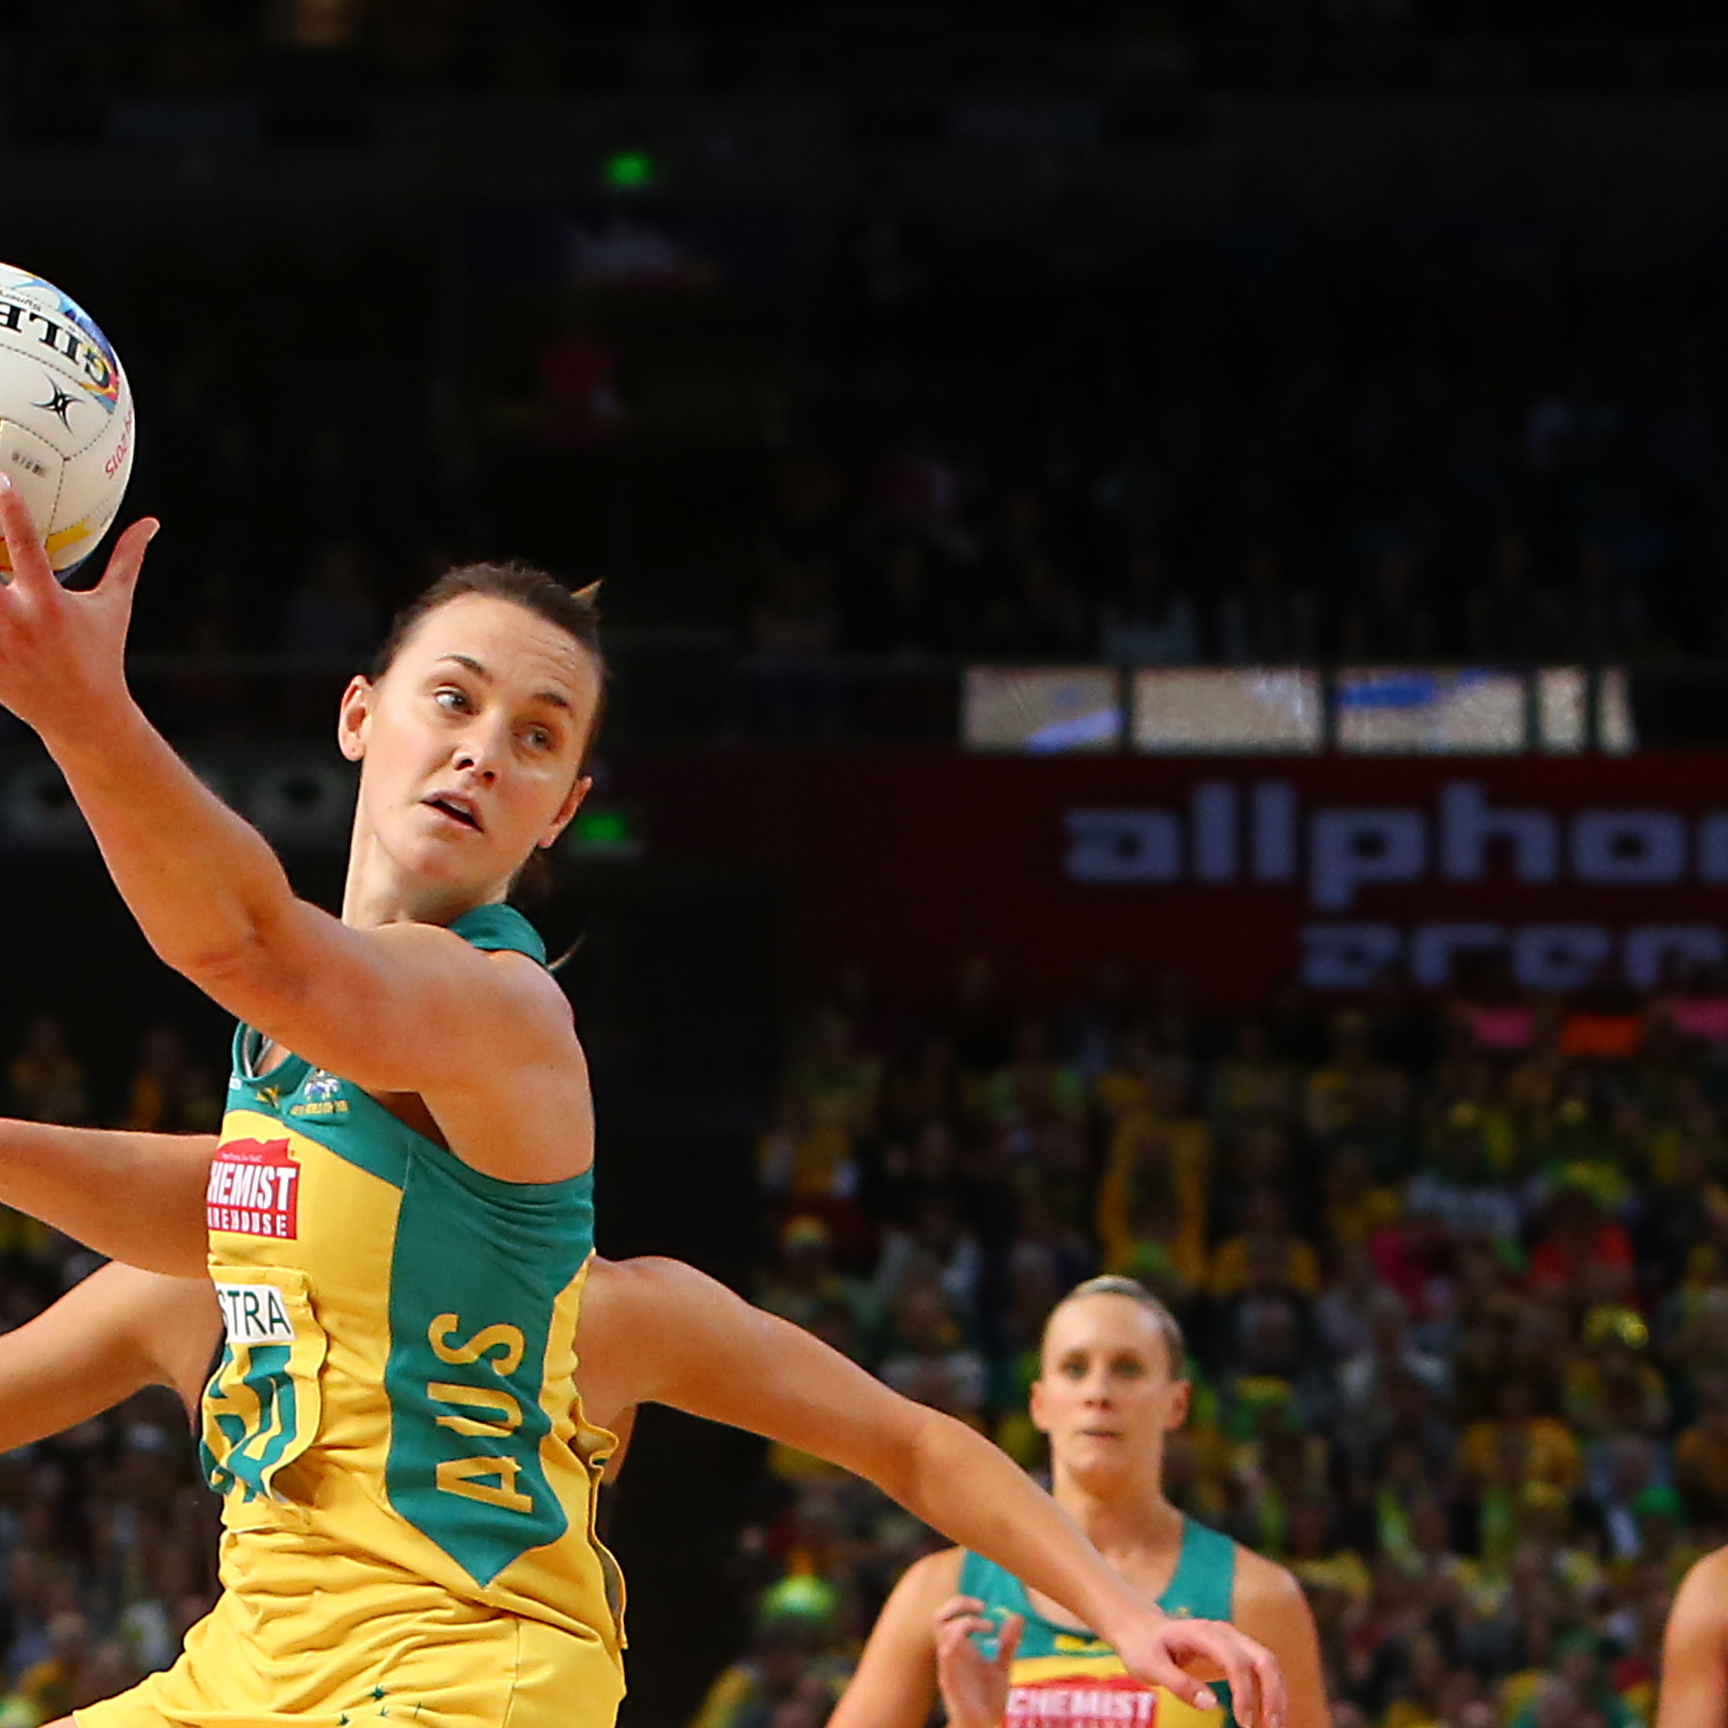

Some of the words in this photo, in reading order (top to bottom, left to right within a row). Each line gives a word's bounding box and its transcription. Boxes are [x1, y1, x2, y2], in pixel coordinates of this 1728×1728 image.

[207, 1161, 297, 1211] HEMIST
[207, 1206, 289, 1237] REHOUSE
[427, 1312, 534, 1515] AUS
